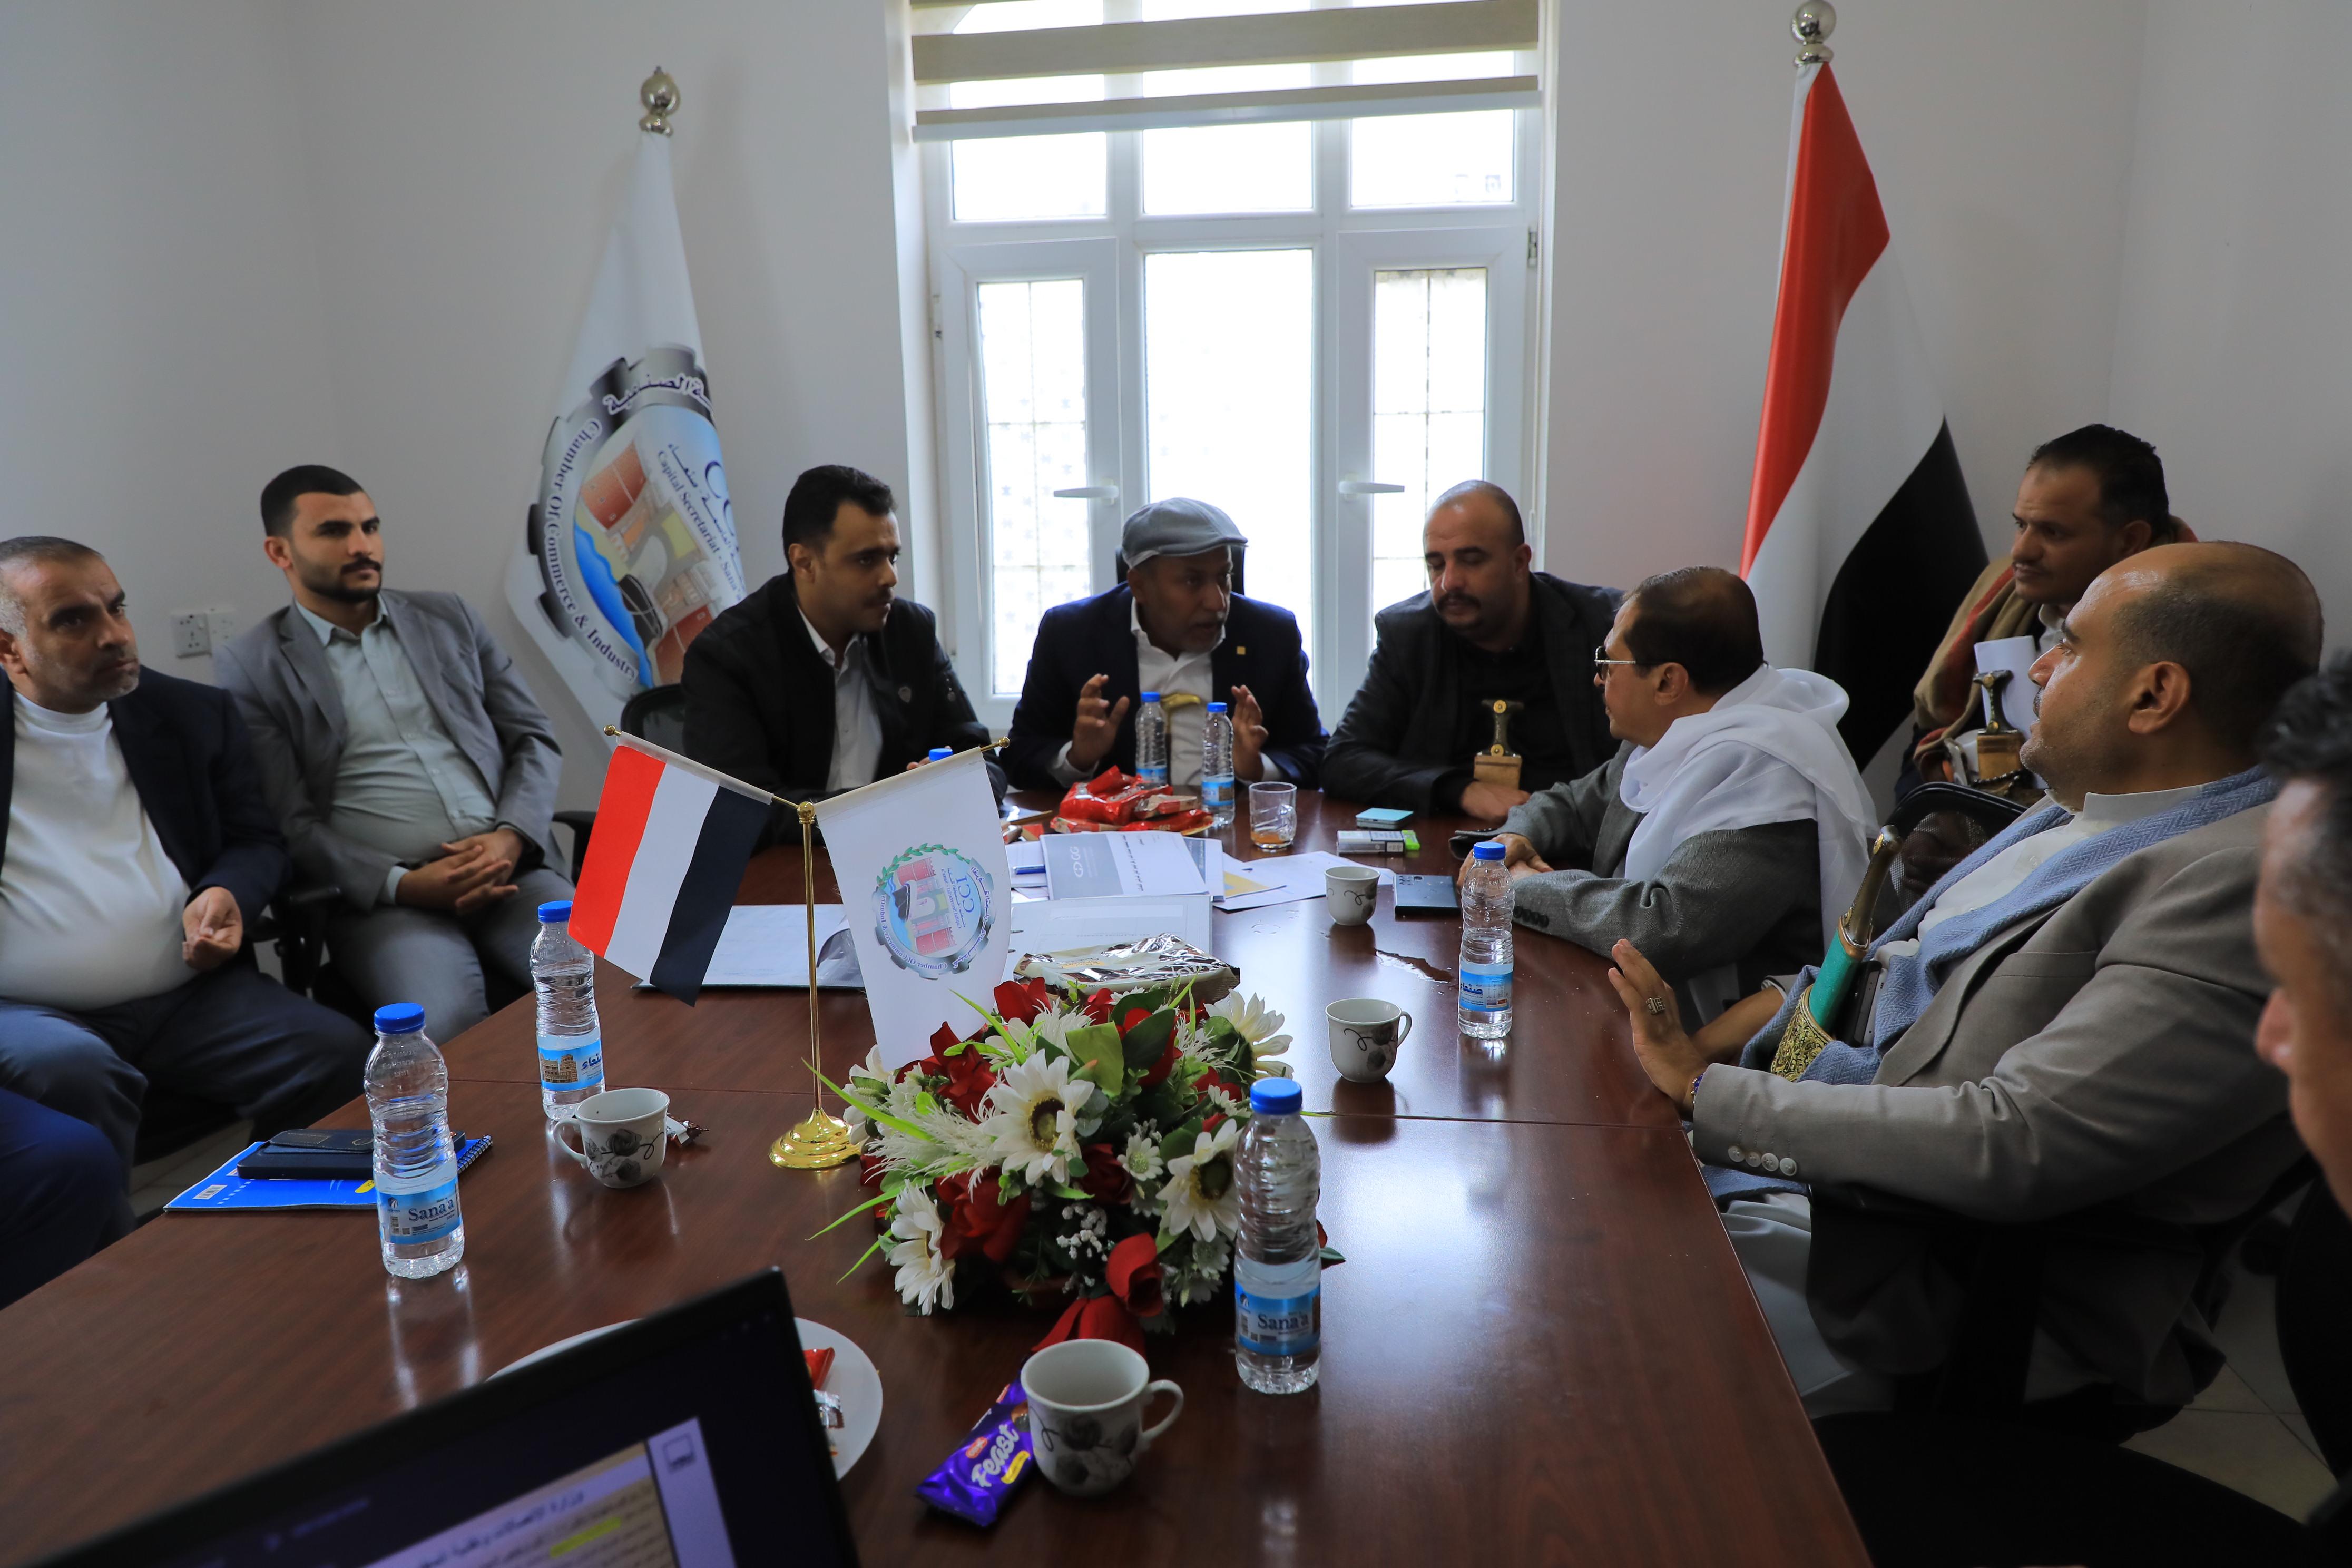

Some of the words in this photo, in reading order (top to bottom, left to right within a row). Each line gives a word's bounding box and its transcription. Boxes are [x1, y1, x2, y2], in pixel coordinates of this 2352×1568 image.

[554, 421, 600, 491] Chamber
[548, 496, 562, 518] Of
[659, 450, 684, 492] Capital
[681, 492, 721, 554] Secretariat
[547, 523, 576, 610] Commerce
[575, 614, 589, 629] &
[581, 1053, 601, 1070] نعاء
[971, 1424, 1020, 1488] Feast
